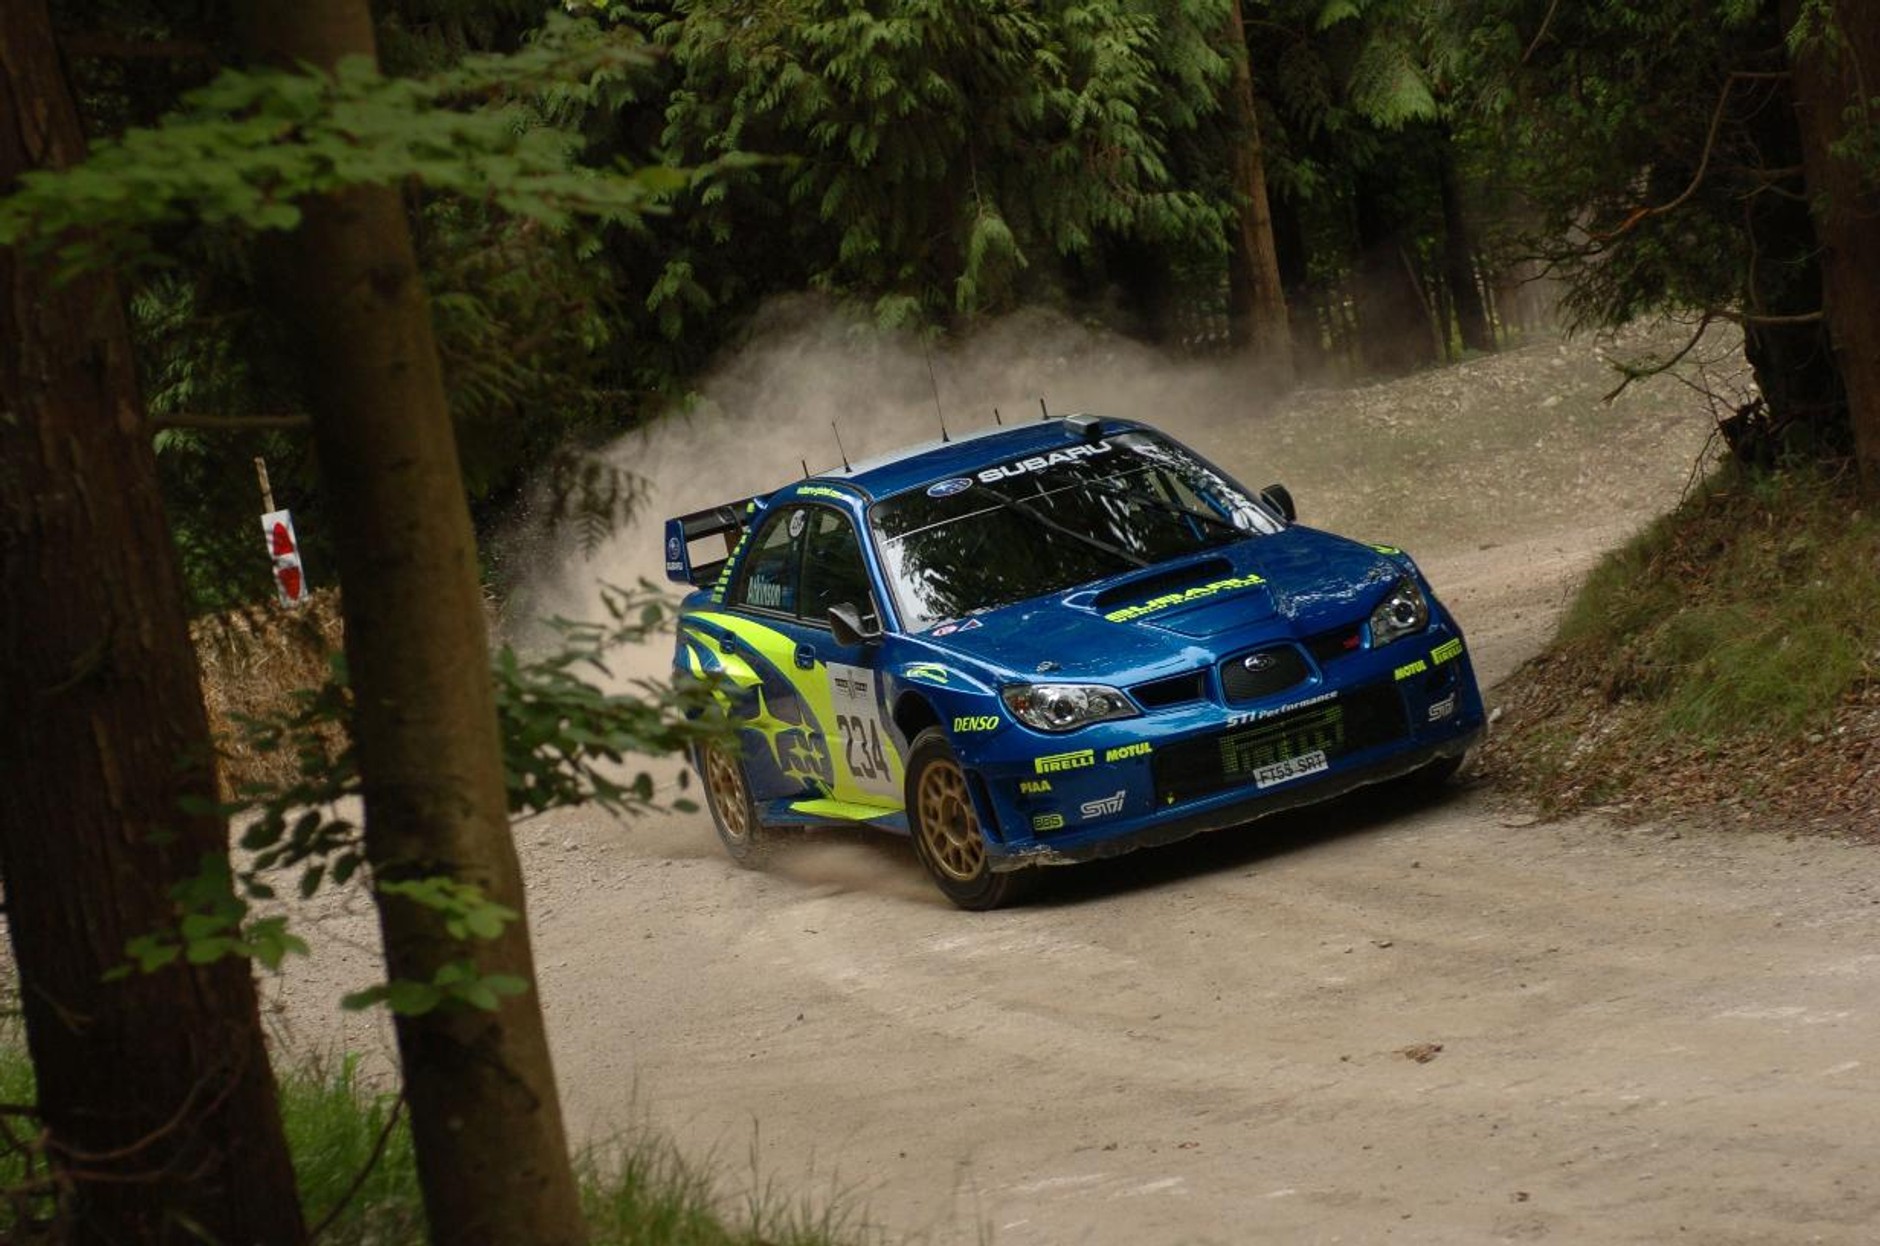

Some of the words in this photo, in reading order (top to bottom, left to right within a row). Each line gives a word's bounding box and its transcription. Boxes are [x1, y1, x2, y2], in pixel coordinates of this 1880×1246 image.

[977, 440, 1112, 484] SUBARU
[1430, 637, 1463, 665] PIRELLI
[1394, 659, 1427, 680] MOTUL
[953, 716, 1000, 732] DENSO
[836, 714, 891, 782] 234
[1106, 742, 1153, 762] MOTUL
[1034, 749, 1095, 774] PIRELLI
[1019, 780, 1052, 794] PIAA
[1034, 814, 1062, 829] BBS
